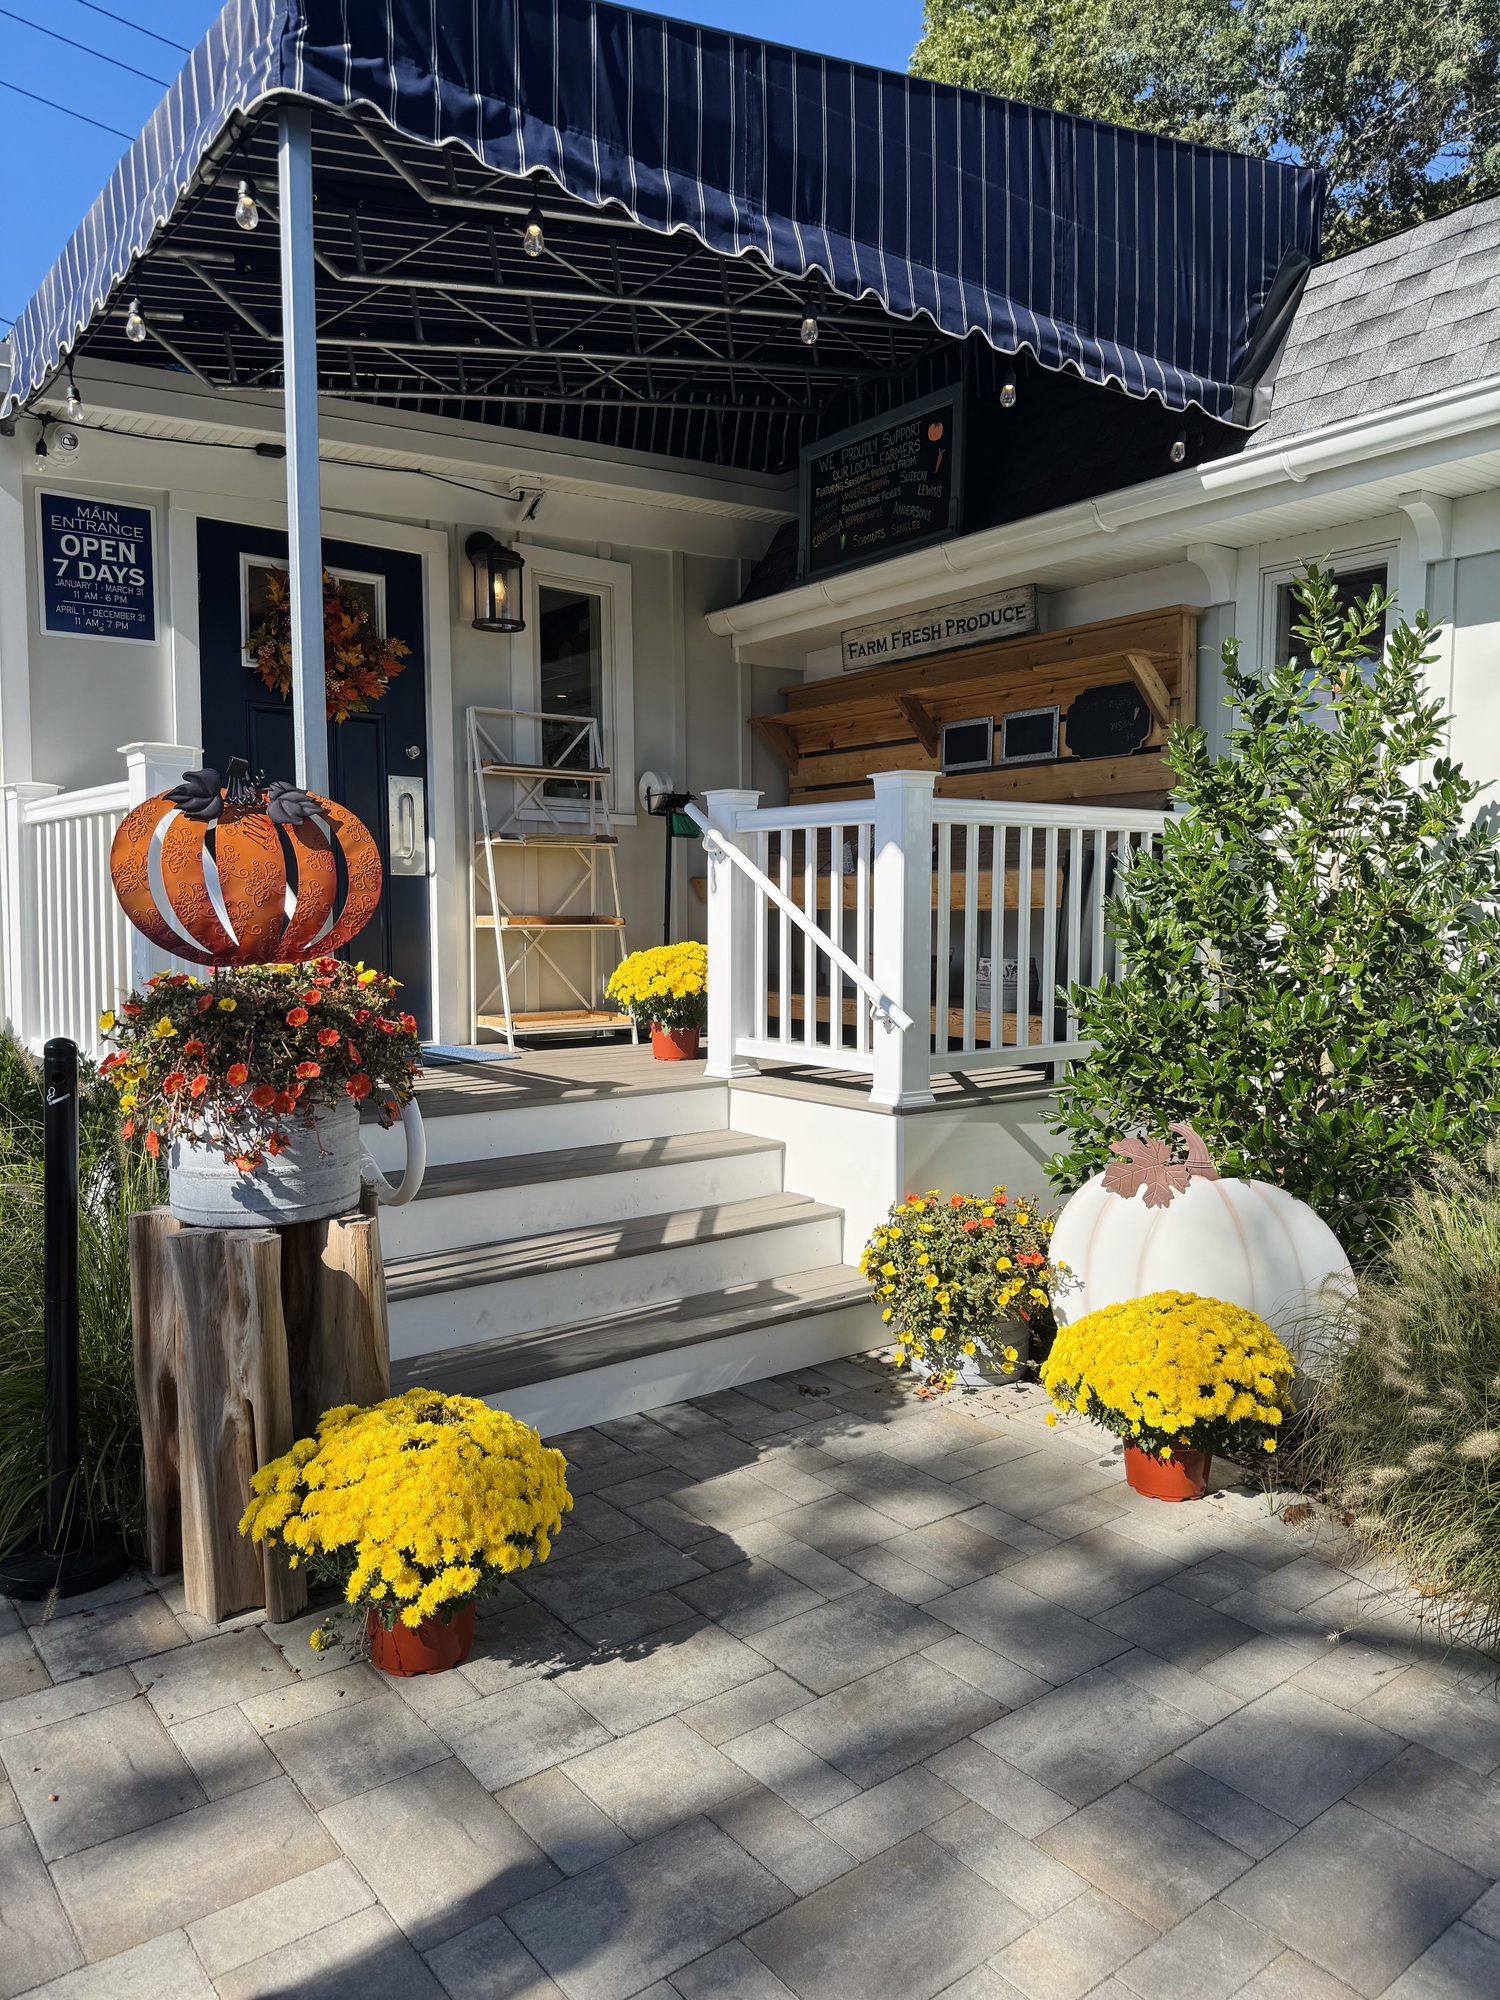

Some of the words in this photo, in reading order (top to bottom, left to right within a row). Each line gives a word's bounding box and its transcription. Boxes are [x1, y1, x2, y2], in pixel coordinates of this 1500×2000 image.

[818, 453, 835, 473] WE
[841, 437, 878, 464] PROUDLY
[883, 421, 922, 448] SUPPORT
[832, 466, 850, 481] OUR
[850, 457, 877, 475] LOCAL
[879, 439, 921, 465] FARMERS
[816, 481, 844, 498] FEATURING
[844, 472, 871, 489] SEASONAL
[871, 462, 896, 478] PRODUCE
[897, 456, 917, 470] FROM
[51, 515, 144, 538] ENTRANCE
[77, 506, 118, 523] MAIN
[60, 534, 137, 564] OPEN
[52, 557, 69, 577] 7
[78, 561, 145, 586] DAYS
[55, 578, 92, 590] JANUARY
[105, 584, 134, 595] MARCH
[136, 588, 144, 596] 31
[73, 591, 80, 599] 11
[84, 592, 98, 601] AM
[105, 594, 112, 602] 6
[114, 595, 127, 604] PM
[55, 605, 79, 615] APRIL
[93, 609, 136, 621] DECEMBER
[137, 614, 146, 622] 31
[74, 618, 81, 626] 11
[85, 618, 99, 627] AM
[106, 621, 113, 629] 7
[115, 622, 129, 630] PM
[848, 637, 888, 660] FARM
[891, 623, 942, 650] FRESH
[945, 604, 1026, 638] PRODUCE
